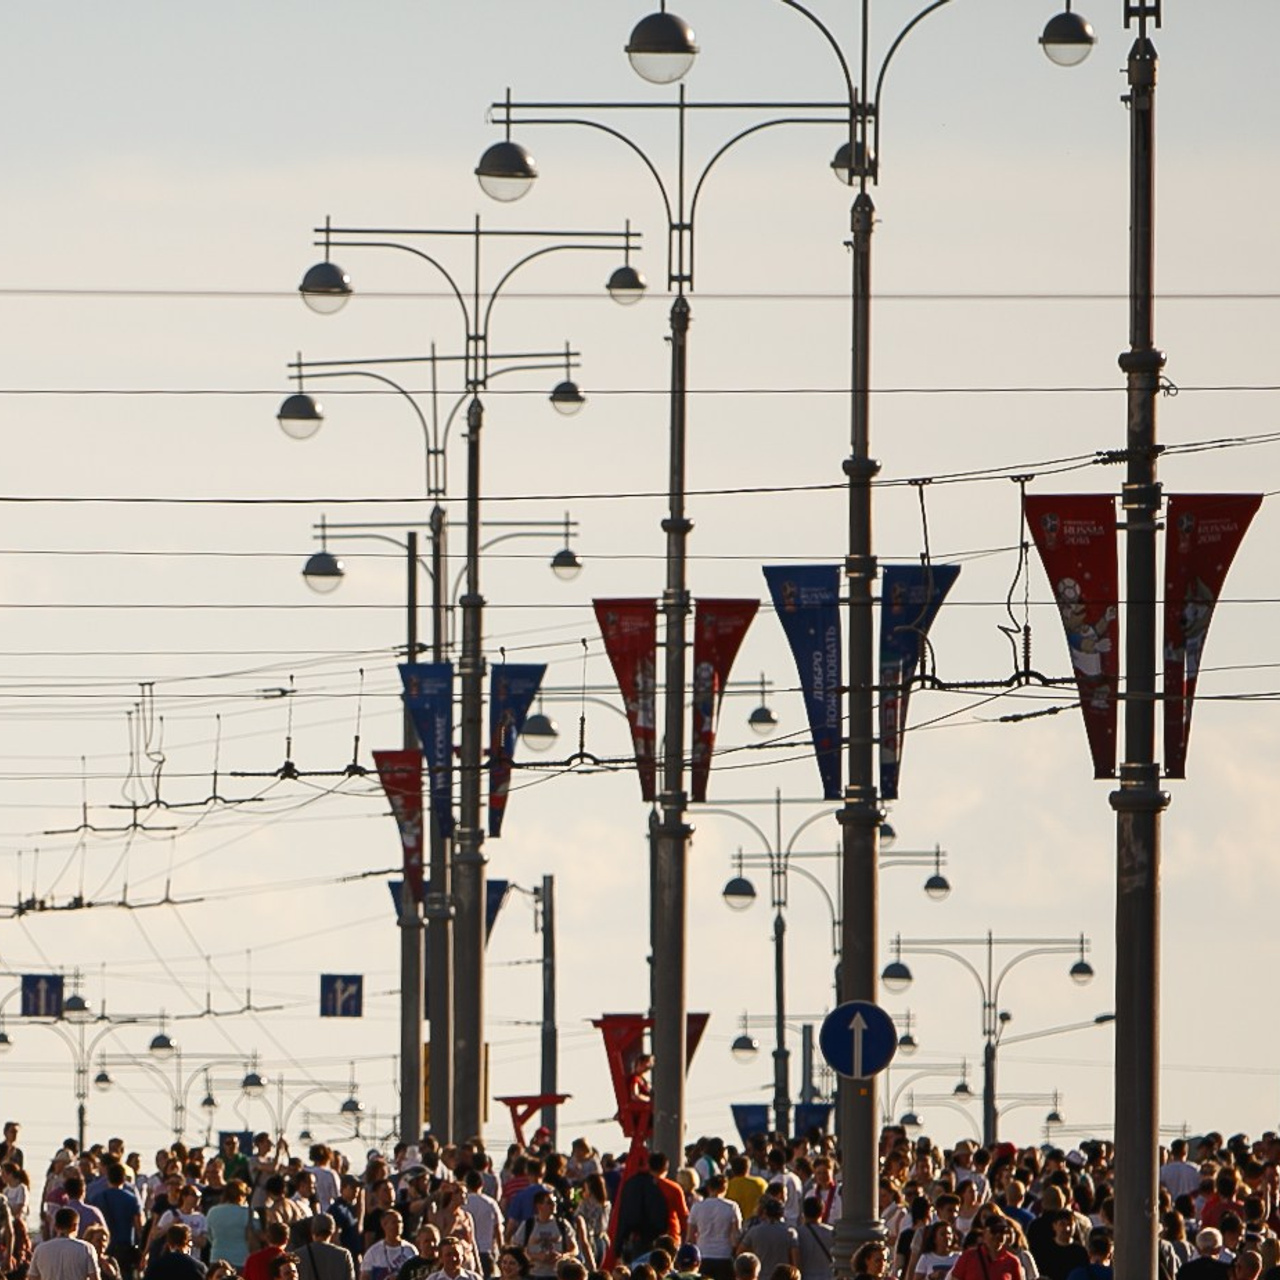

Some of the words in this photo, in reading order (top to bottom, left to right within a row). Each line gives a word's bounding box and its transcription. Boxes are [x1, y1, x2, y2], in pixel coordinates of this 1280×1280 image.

[1063, 525, 1105, 536] RUSSIA
[1197, 522, 1239, 534] RUSSIA
[813, 650, 824, 701] ДОБРО
[825, 625, 838, 728] ПОЖАЛОВАТЬ
